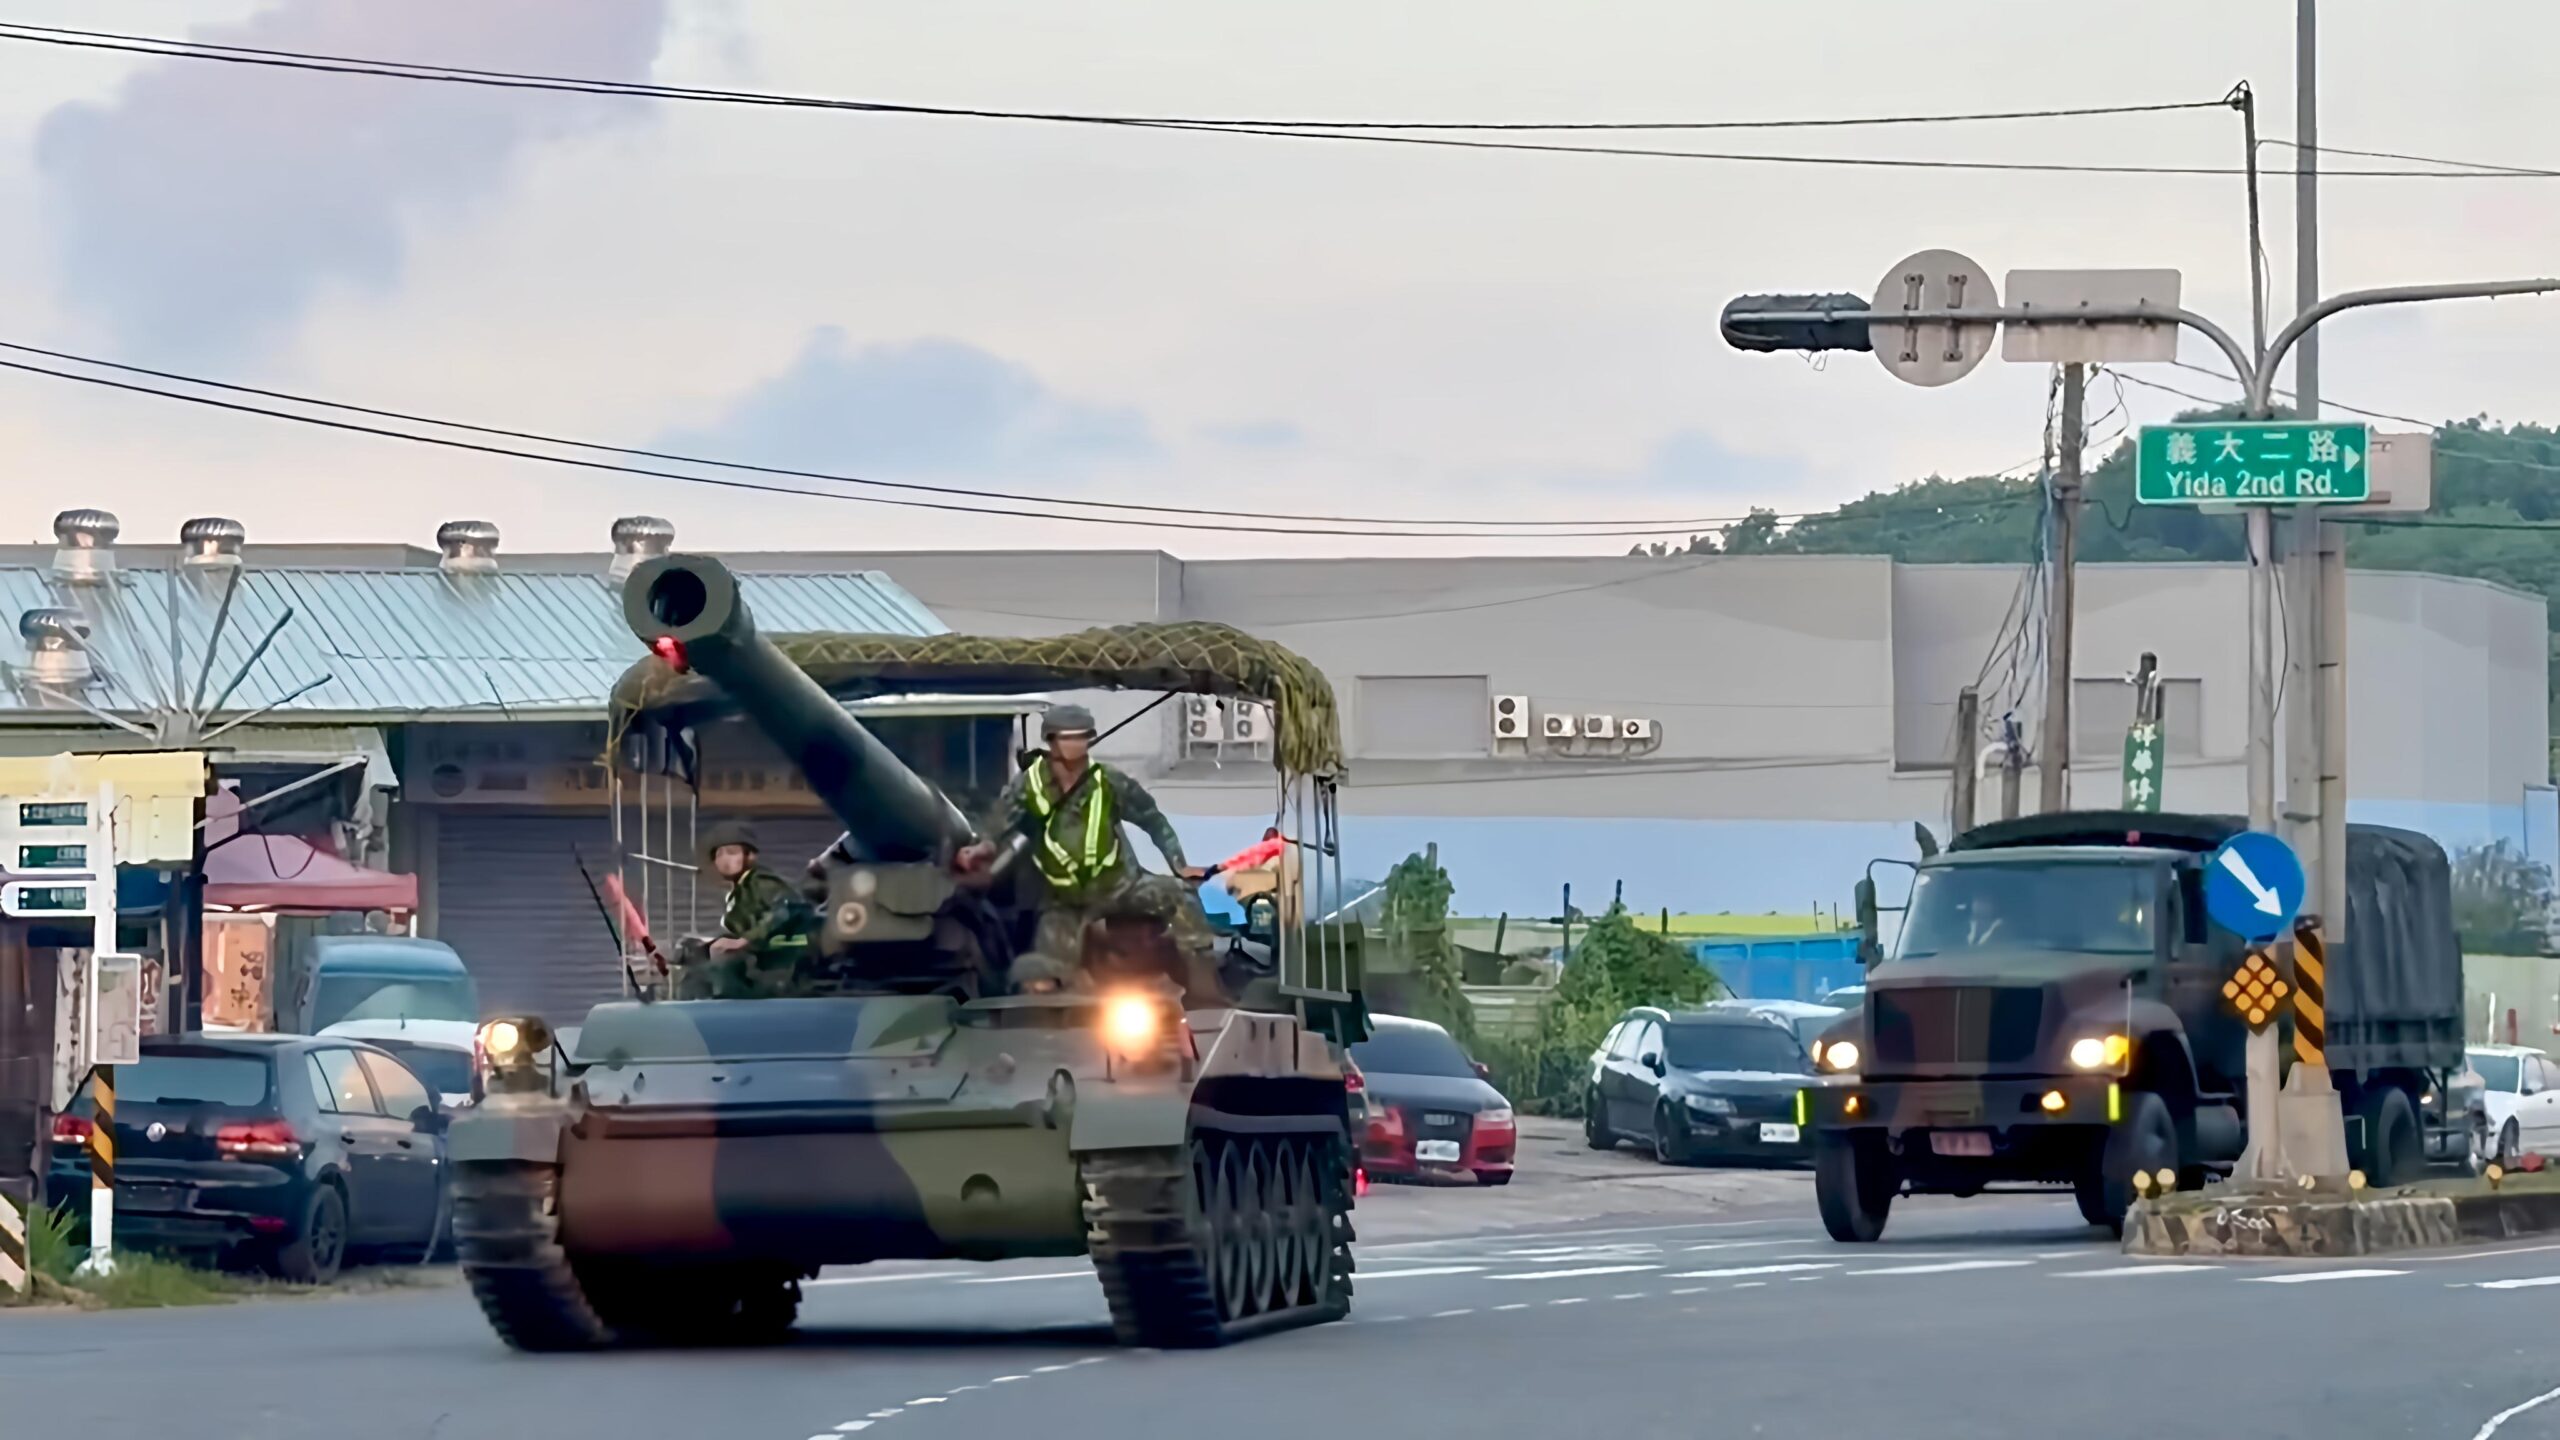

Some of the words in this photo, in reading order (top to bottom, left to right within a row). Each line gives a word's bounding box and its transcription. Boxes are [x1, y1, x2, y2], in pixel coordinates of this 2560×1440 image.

[2166, 430, 2339, 465] 義大二路
[2166, 471, 2226, 496] Yida
[2236, 471, 2285, 495] 2nd
[2296, 468, 2339, 495] Rd.
